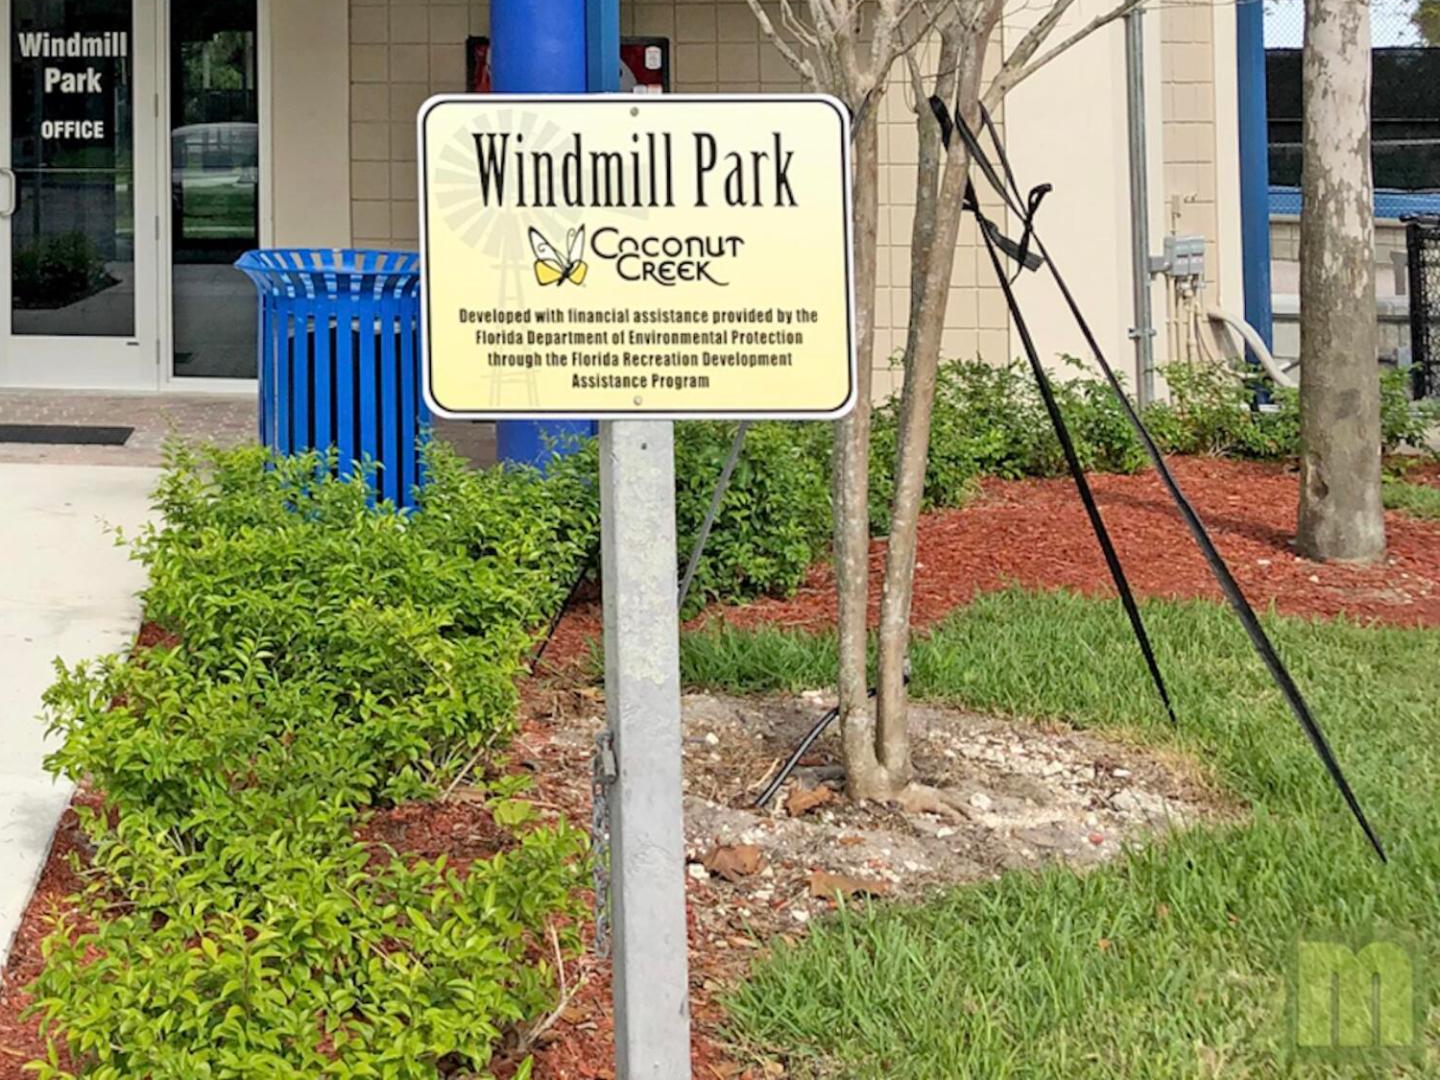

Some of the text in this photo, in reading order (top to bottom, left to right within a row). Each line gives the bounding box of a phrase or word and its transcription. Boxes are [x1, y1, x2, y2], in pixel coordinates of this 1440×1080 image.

[19, 31, 127, 58] Windmill
[44, 67, 102, 93] Park
[41, 120, 104, 140] OFFICE
[472, 132, 798, 208] Windmill Park
[459, 308, 818, 325] Developed with financial assistance provided by the
[476, 330, 803, 347] Florida Department of Environmental Protection
[487, 351, 792, 369] through the Florida Recreation Development
[572, 373, 710, 390] Assistance Program
